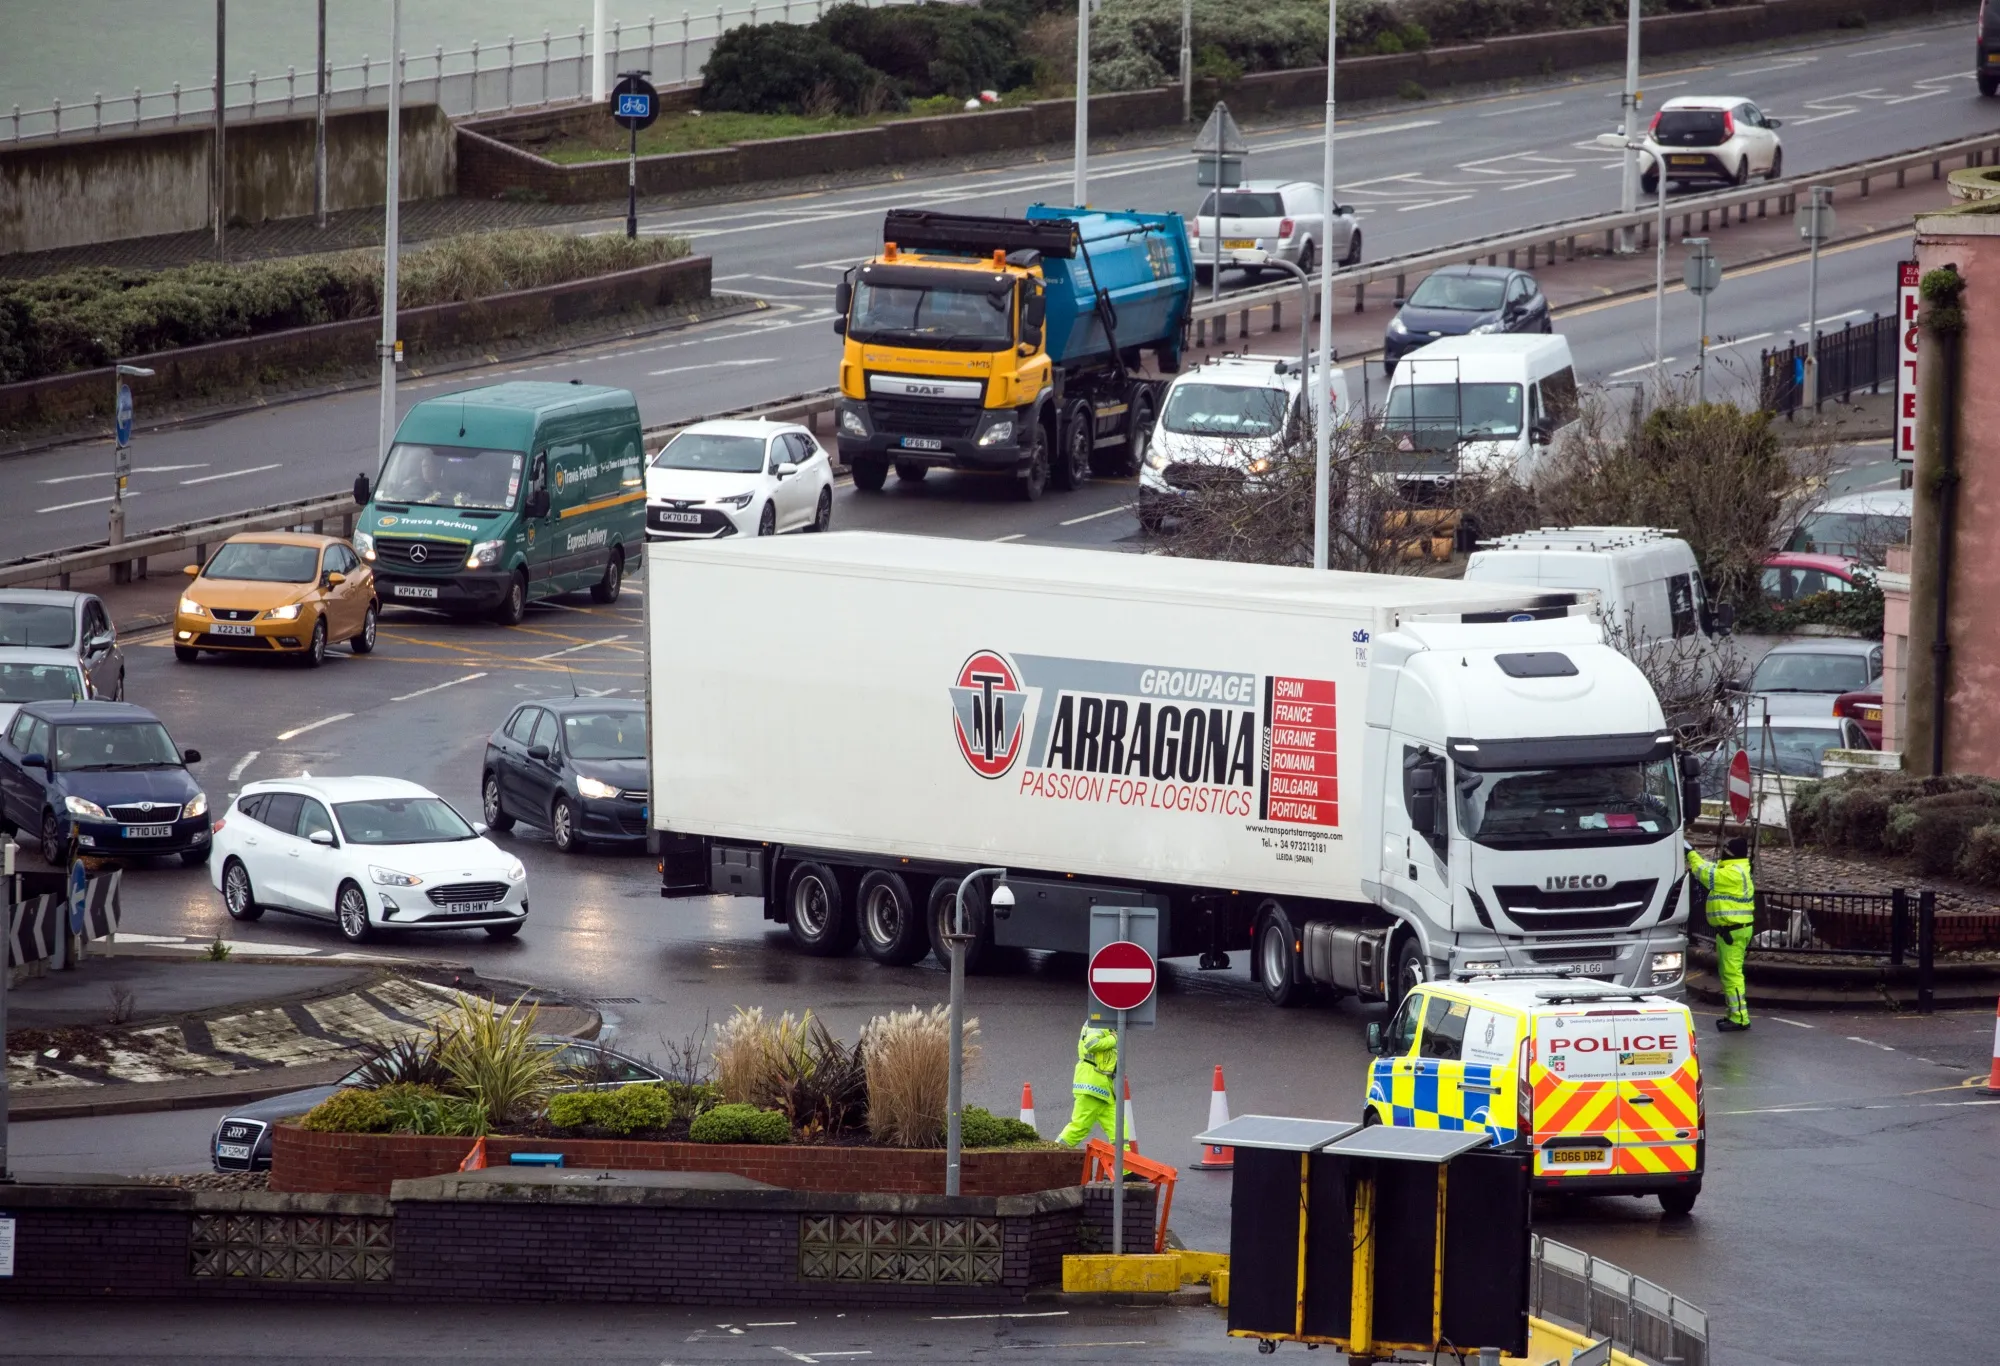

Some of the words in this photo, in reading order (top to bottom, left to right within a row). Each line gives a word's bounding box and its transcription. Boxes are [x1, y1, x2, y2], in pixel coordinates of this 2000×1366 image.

[906, 385, 944, 394] DAF
[905, 438, 924, 447] GF66
[564, 468, 579, 484] Travis
[579, 465, 597, 481] Perkins
[435, 519, 478, 531] Perkins
[662, 512, 681, 521] GK70
[566, 533, 587, 553] Express
[587, 528, 608, 546] Delivery
[398, 587, 416, 596] KP14
[418, 588, 433, 597] YZC
[217, 625, 234, 634] X22
[235, 626, 252, 635] LSM
[1141, 668, 1254, 702] GROUPAGE
[1276, 680, 1304, 698] SPAIN
[1012, 655, 1255, 787] TARRAGONA
[1275, 704, 1313, 723] FRANCE
[1274, 729, 1316, 747] UKRAINE
[1262, 726, 1272, 771] OFFICES
[1273, 753, 1315, 771] ROMANIA
[1020, 770, 1104, 802] PASSION
[1106, 779, 1147, 806] FOR
[1151, 783, 1252, 817] LOGISTICS
[1272, 777, 1318, 796] BULGARIA
[1271, 802, 1317, 821] PORTUGAL
[129, 827, 150, 836] FT10
[151, 826, 169, 836] UVE
[1245, 823, 1343, 841] www.transportstarragona.com
[1261, 838, 1272, 848] Tel.
[1280, 839, 1289, 849] 34
[1290, 840, 1327, 853] 973212181
[1275, 853, 1293, 862] LLEIDA
[1294, 855, 1313, 865] (SPAIN)
[1546, 874, 1608, 890] IVECO
[451, 903, 471, 912] ET19
[472, 902, 488, 911] HWY
[1584, 963, 1601, 973] LGG
[1550, 1035, 1678, 1053] POLICE
[1583, 1150, 1603, 1161] DBZ
